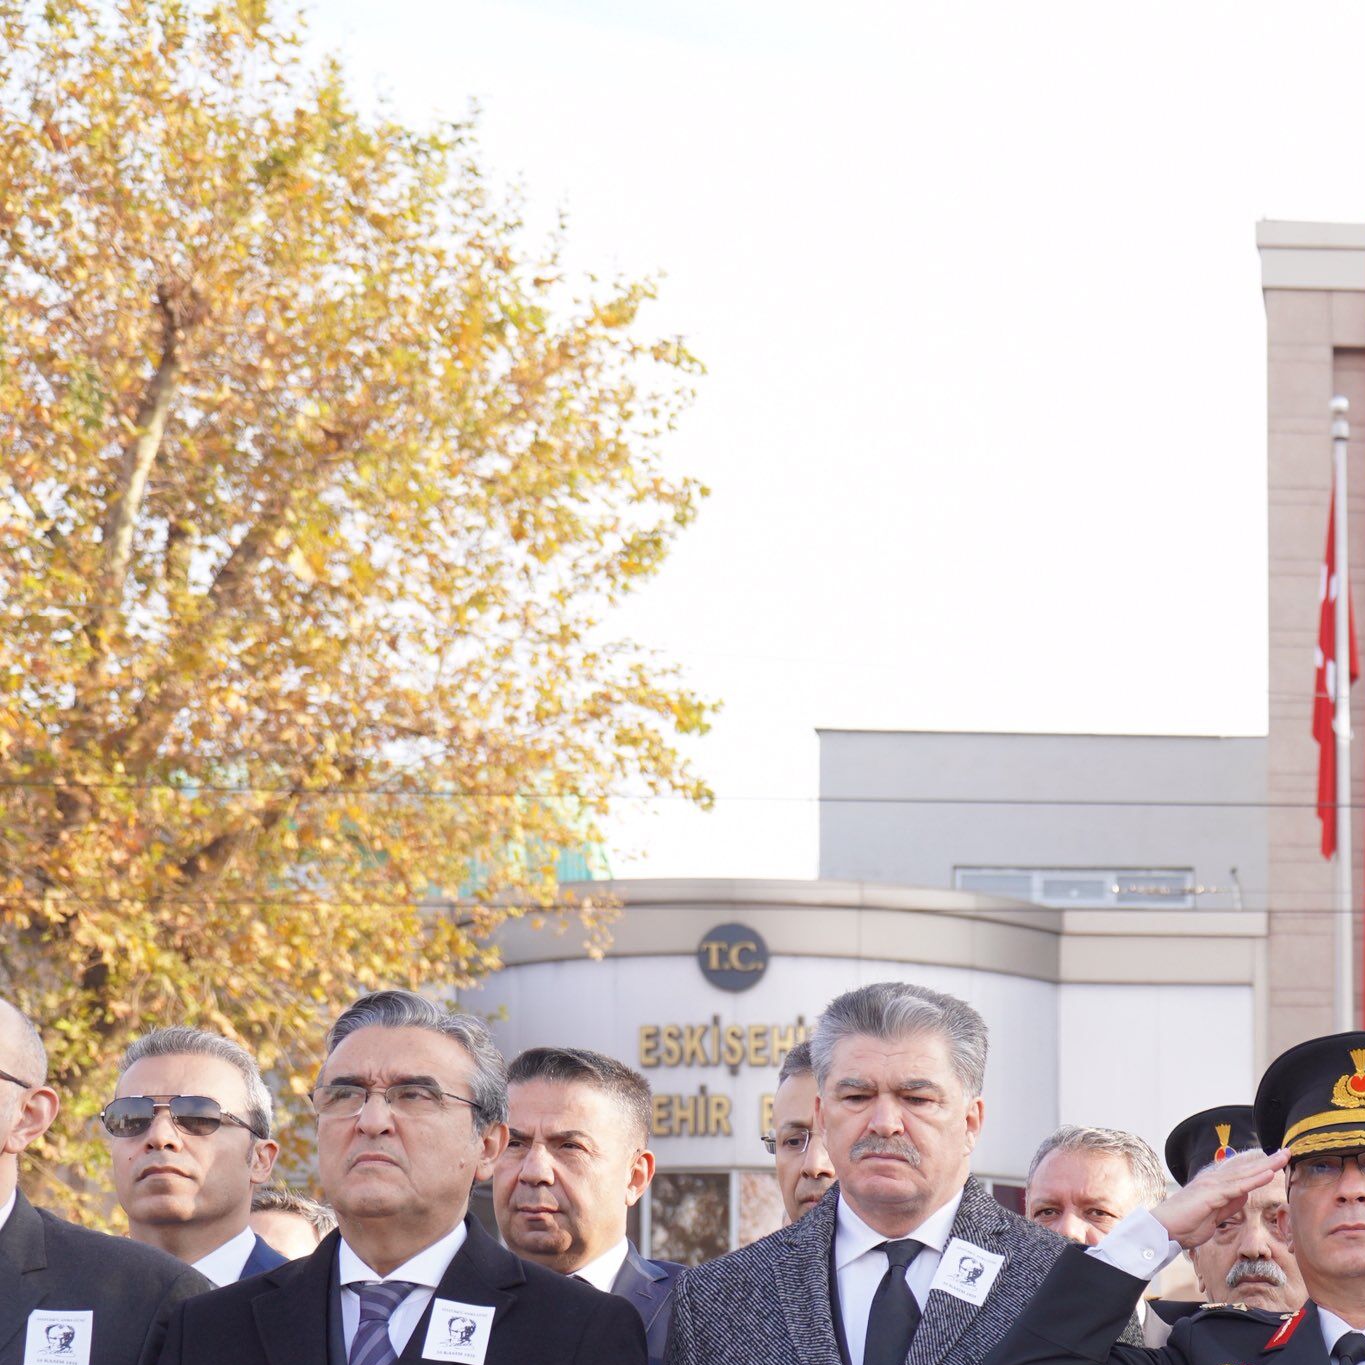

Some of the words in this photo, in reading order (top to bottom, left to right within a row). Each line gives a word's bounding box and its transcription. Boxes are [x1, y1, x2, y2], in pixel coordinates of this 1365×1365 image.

[702, 941, 764, 971] T.C.
[638, 1014, 812, 1076] ESKİŞEHİ
[652, 1084, 732, 1137] EHİR
